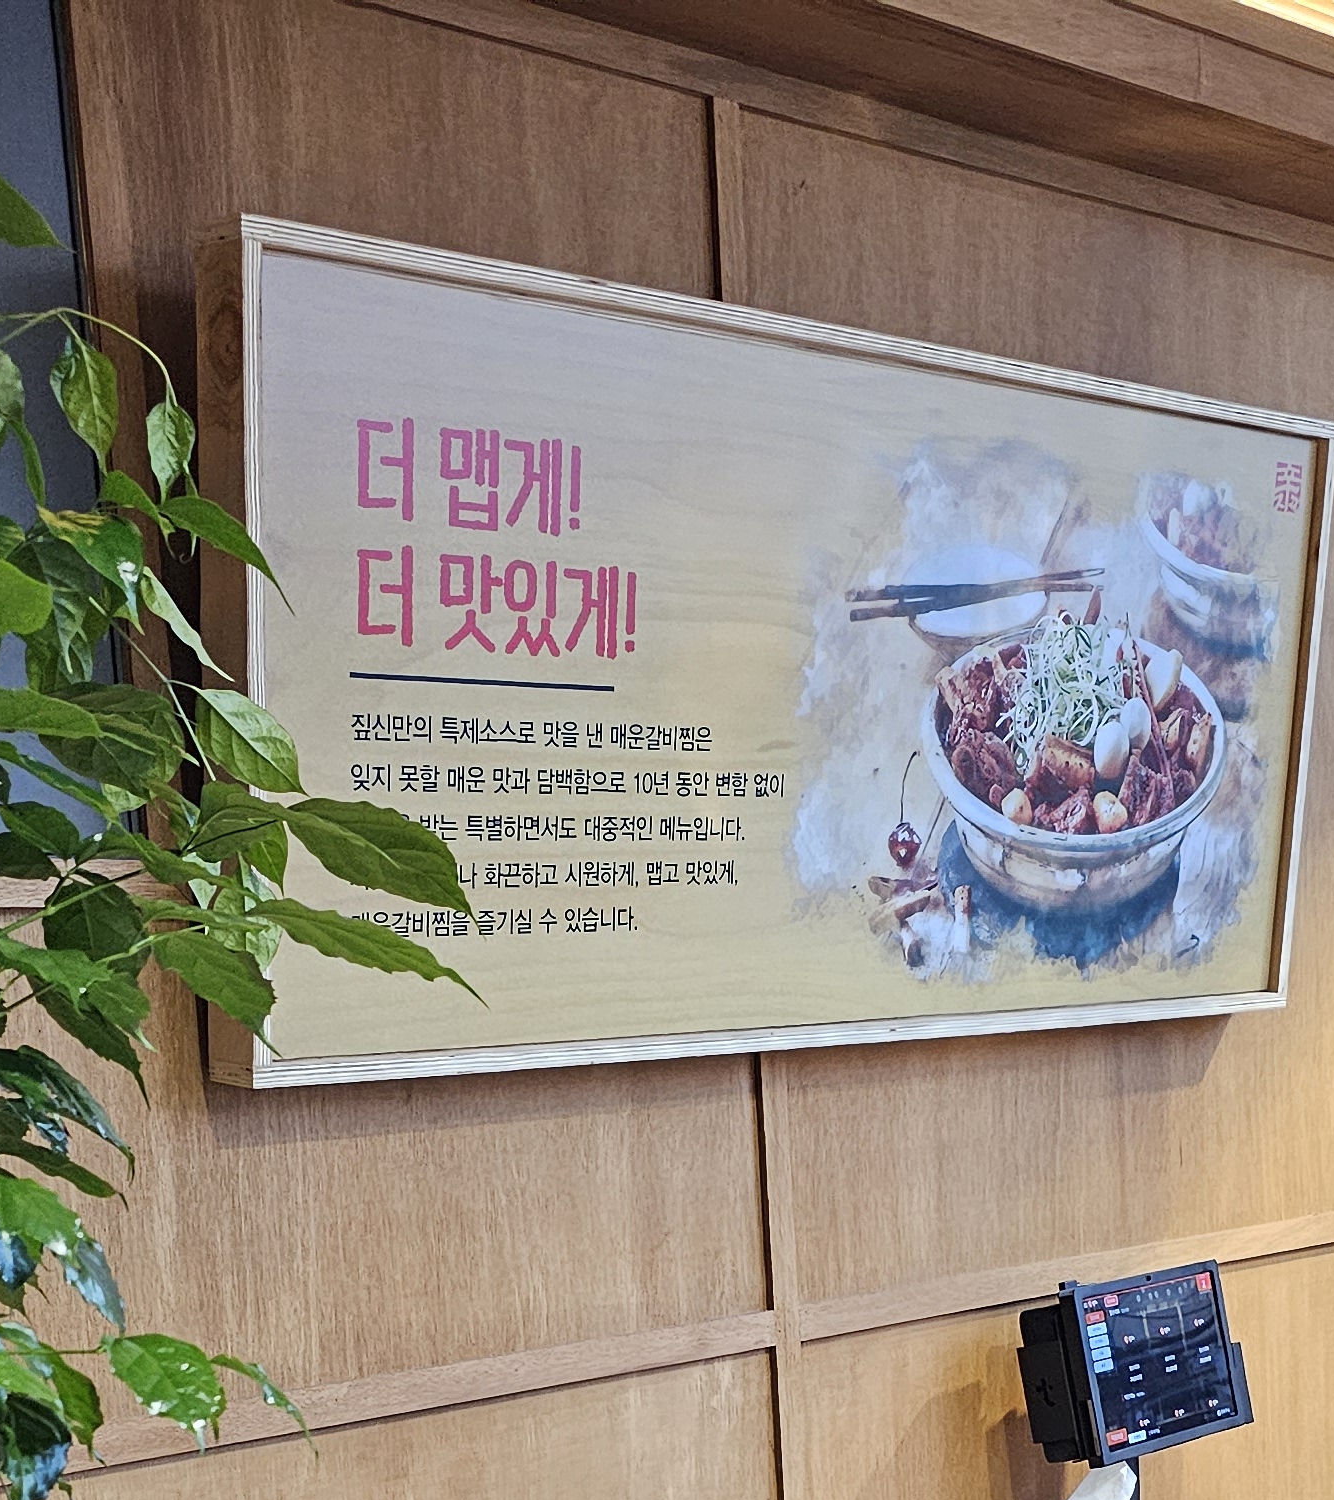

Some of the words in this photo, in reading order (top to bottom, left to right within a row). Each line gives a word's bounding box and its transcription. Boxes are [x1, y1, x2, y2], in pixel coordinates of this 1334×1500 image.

[357, 417, 414, 522] 더
[439, 427, 582, 537] 맵게!
[357, 545, 414, 647] 더
[439, 553, 638, 659] 맛있게!
[351, 713, 432, 744] 짚신만의
[439, 716, 536, 744] 특제소스로
[543, 720, 580, 748] 맛을
[586, 722, 603, 748] 낸
[610, 723, 713, 752] 매운갈비찜은
[350, 763, 391, 792] 잊지
[399, 764, 440, 793] 못할
[447, 766, 486, 793] 매운
[492, 767, 530, 794] 맛과
[537, 768, 626, 795] 담백함으로
[633, 770, 669, 796] 10년
[675, 771, 709, 797] 동안
[716, 772, 749, 797] 변함
[753, 772, 785, 797] 없이
[465, 815, 577, 841] 특별하면서도
[584, 815, 653, 841] 대중적인
[659, 816, 745, 842] 메뉴입니다.
[483, 862, 558, 888] 화끈하고
[565, 861, 639, 888] 시원하게,
[646, 861, 680, 886] 맵고
[685, 860, 738, 886] 맛있게,
[477, 908, 532, 936] 즐기실
[538, 908, 558, 934] 수
[564, 906, 638, 933] 있습니다.
